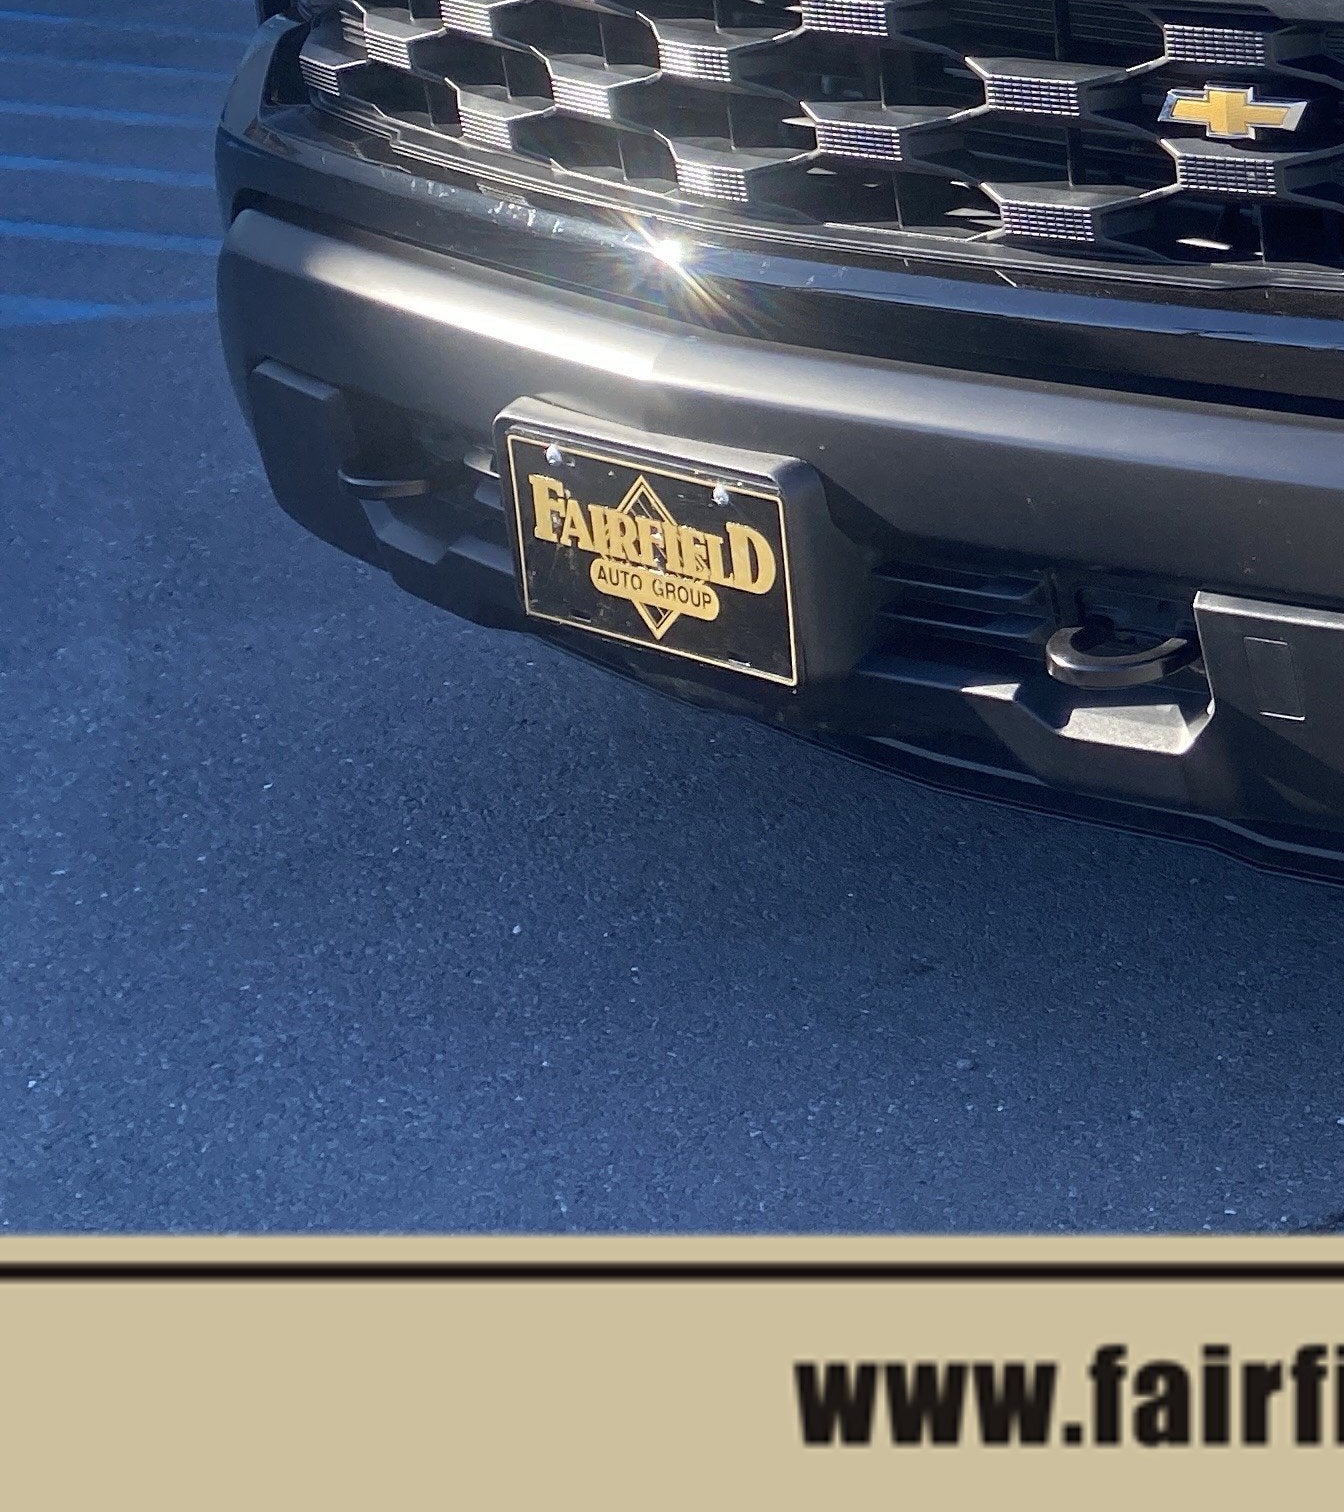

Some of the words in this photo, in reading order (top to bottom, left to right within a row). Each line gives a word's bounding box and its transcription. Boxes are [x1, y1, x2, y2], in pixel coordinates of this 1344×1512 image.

[528, 473, 777, 595] FAIRFIELD
[597, 564, 644, 592] AUTO
[652, 578, 713, 610] GROUP
